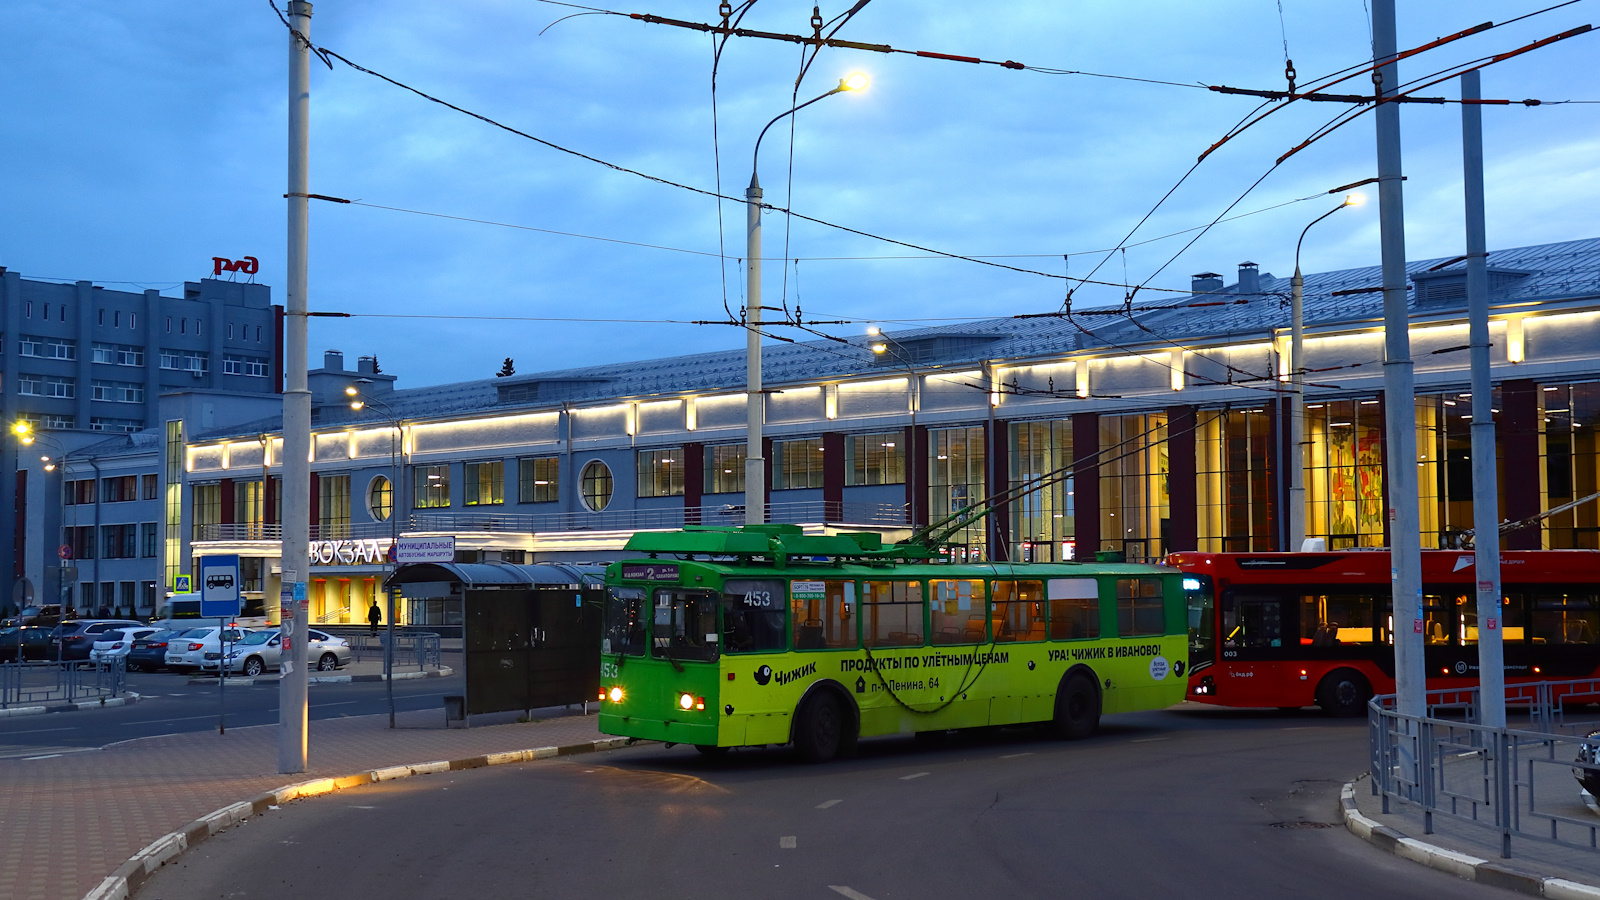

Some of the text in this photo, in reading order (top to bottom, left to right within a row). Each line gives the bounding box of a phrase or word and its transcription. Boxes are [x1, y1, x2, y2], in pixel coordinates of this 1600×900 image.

[310, 540, 383, 564] ВОКЗАЛ
[398, 542, 453, 550] МУНИЦИПАЛЬНЫЕ
[646, 567, 655, 580] 2
[743, 591, 771, 607] 453
[1048, 644, 1161, 662] УРА! ЧИЖИК В ИВАНОВО!
[840, 651, 1010, 673] ПРОДУКТЫ ПО УЛЁТНЫМ ЦЕНАМ
[775, 662, 817, 686] Чижик
[871, 677, 940, 693] п-т Ленина, 64
